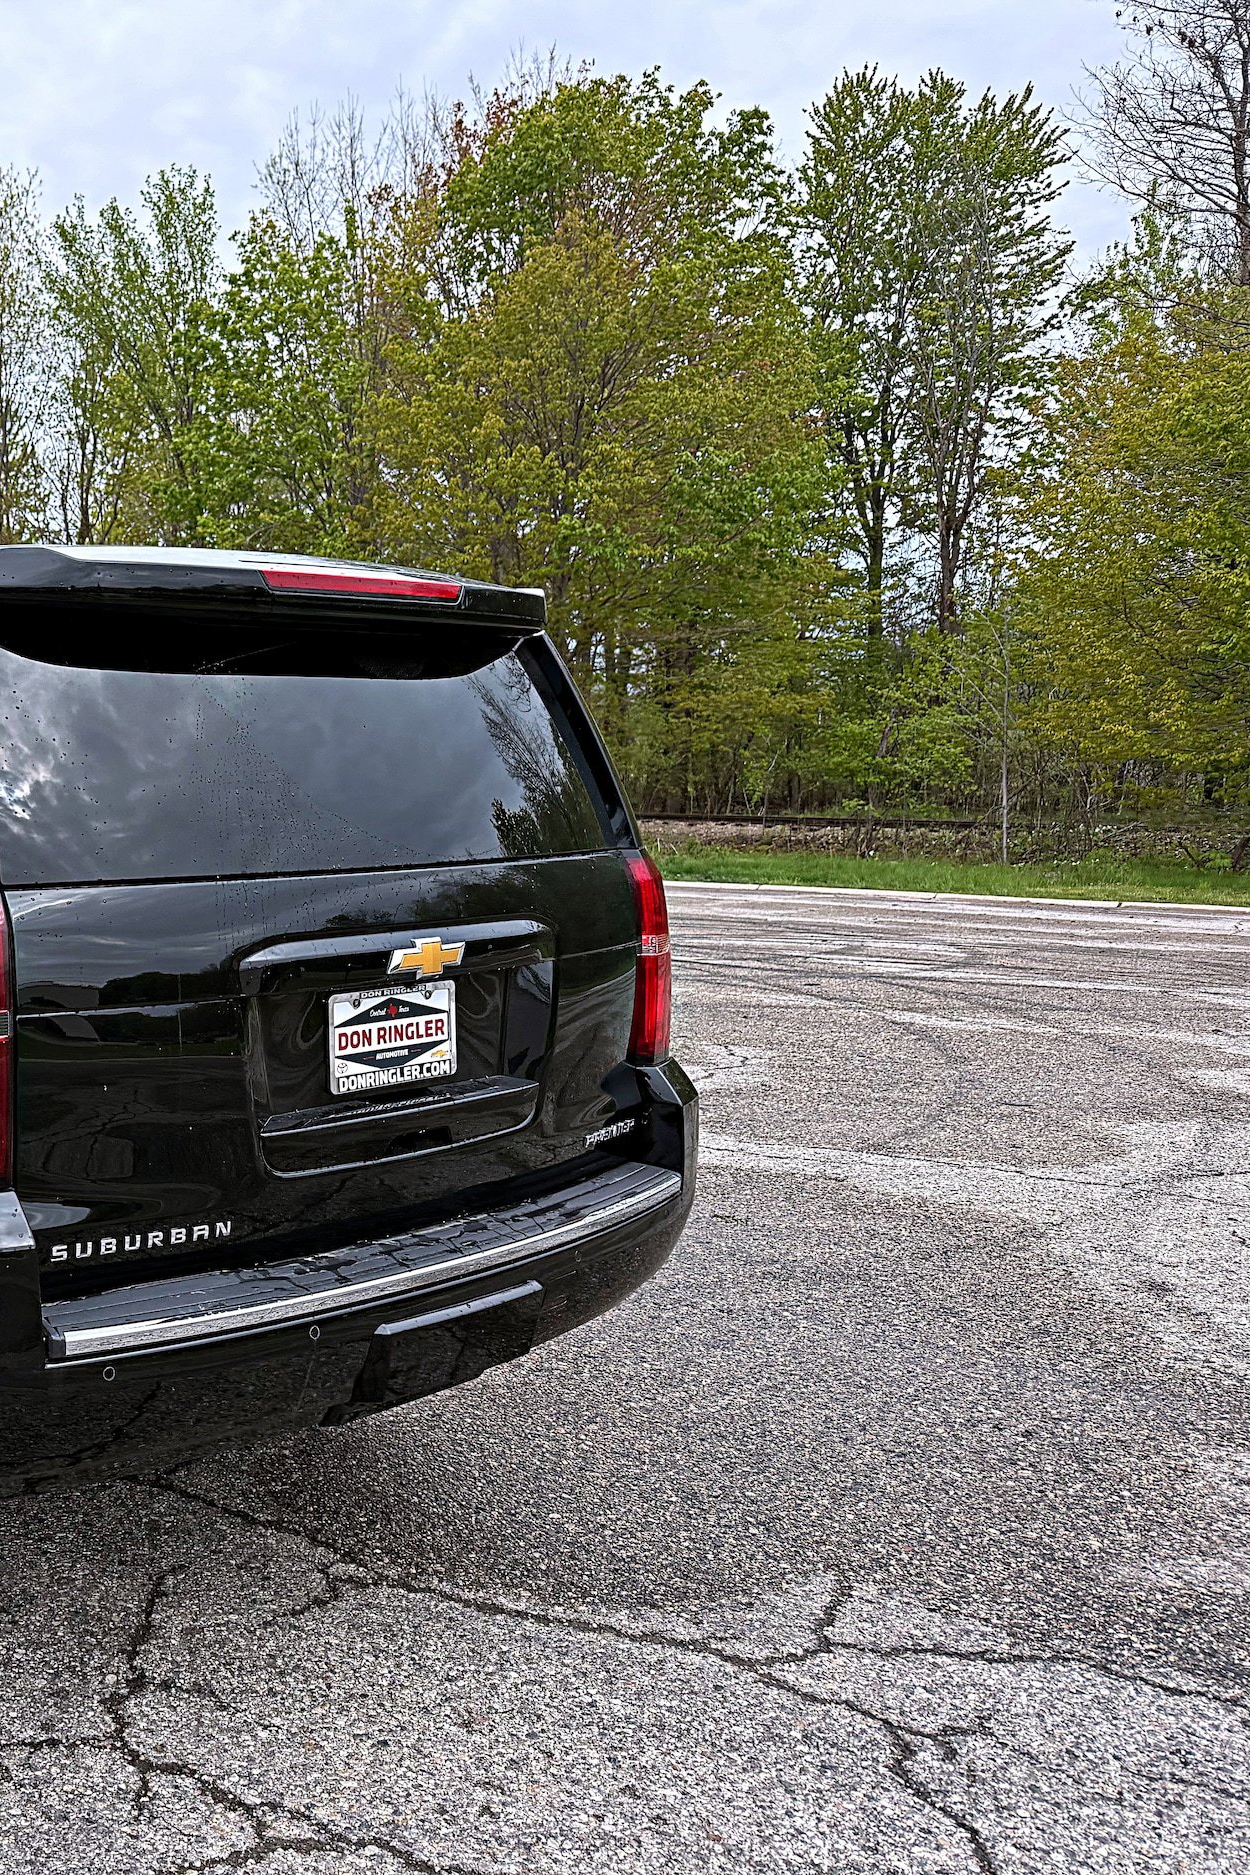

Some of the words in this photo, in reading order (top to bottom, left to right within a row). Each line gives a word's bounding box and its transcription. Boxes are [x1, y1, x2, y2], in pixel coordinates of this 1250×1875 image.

[361, 991, 382, 999] DON
[384, 985, 426, 996] RINGLER
[369, 1008, 386, 1017] Central
[338, 1028, 372, 1051] DON
[377, 1019, 444, 1045] RINGLER
[376, 1049, 409, 1060] AUTOMOTIVE
[339, 1060, 450, 1092] DONRINGLER.COM
[50, 1220, 231, 1262] SUBURBAN
